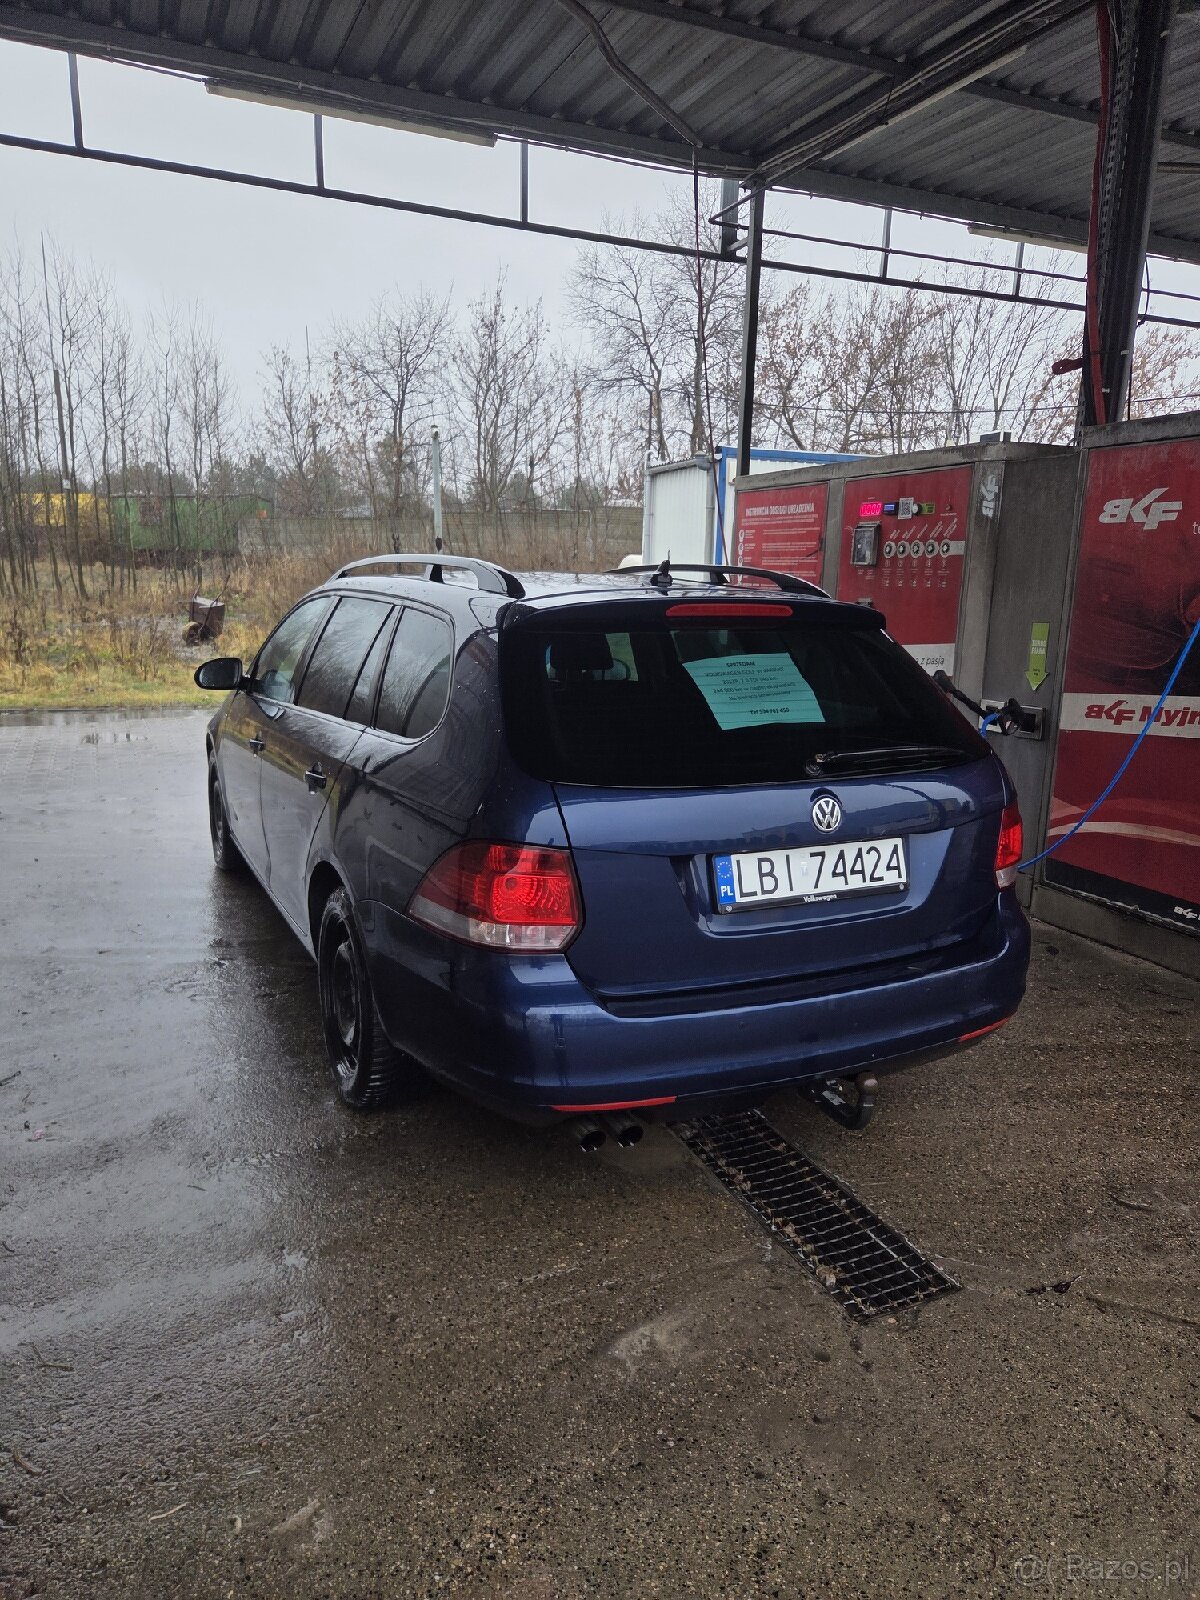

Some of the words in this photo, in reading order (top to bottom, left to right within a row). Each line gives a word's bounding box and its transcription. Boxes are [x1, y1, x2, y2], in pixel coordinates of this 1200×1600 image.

[736, 853, 794, 899] LBI
[809, 843, 903, 890] 74424
[720, 885, 734, 897] PL
[803, 893, 838, 903] Volkswagen
